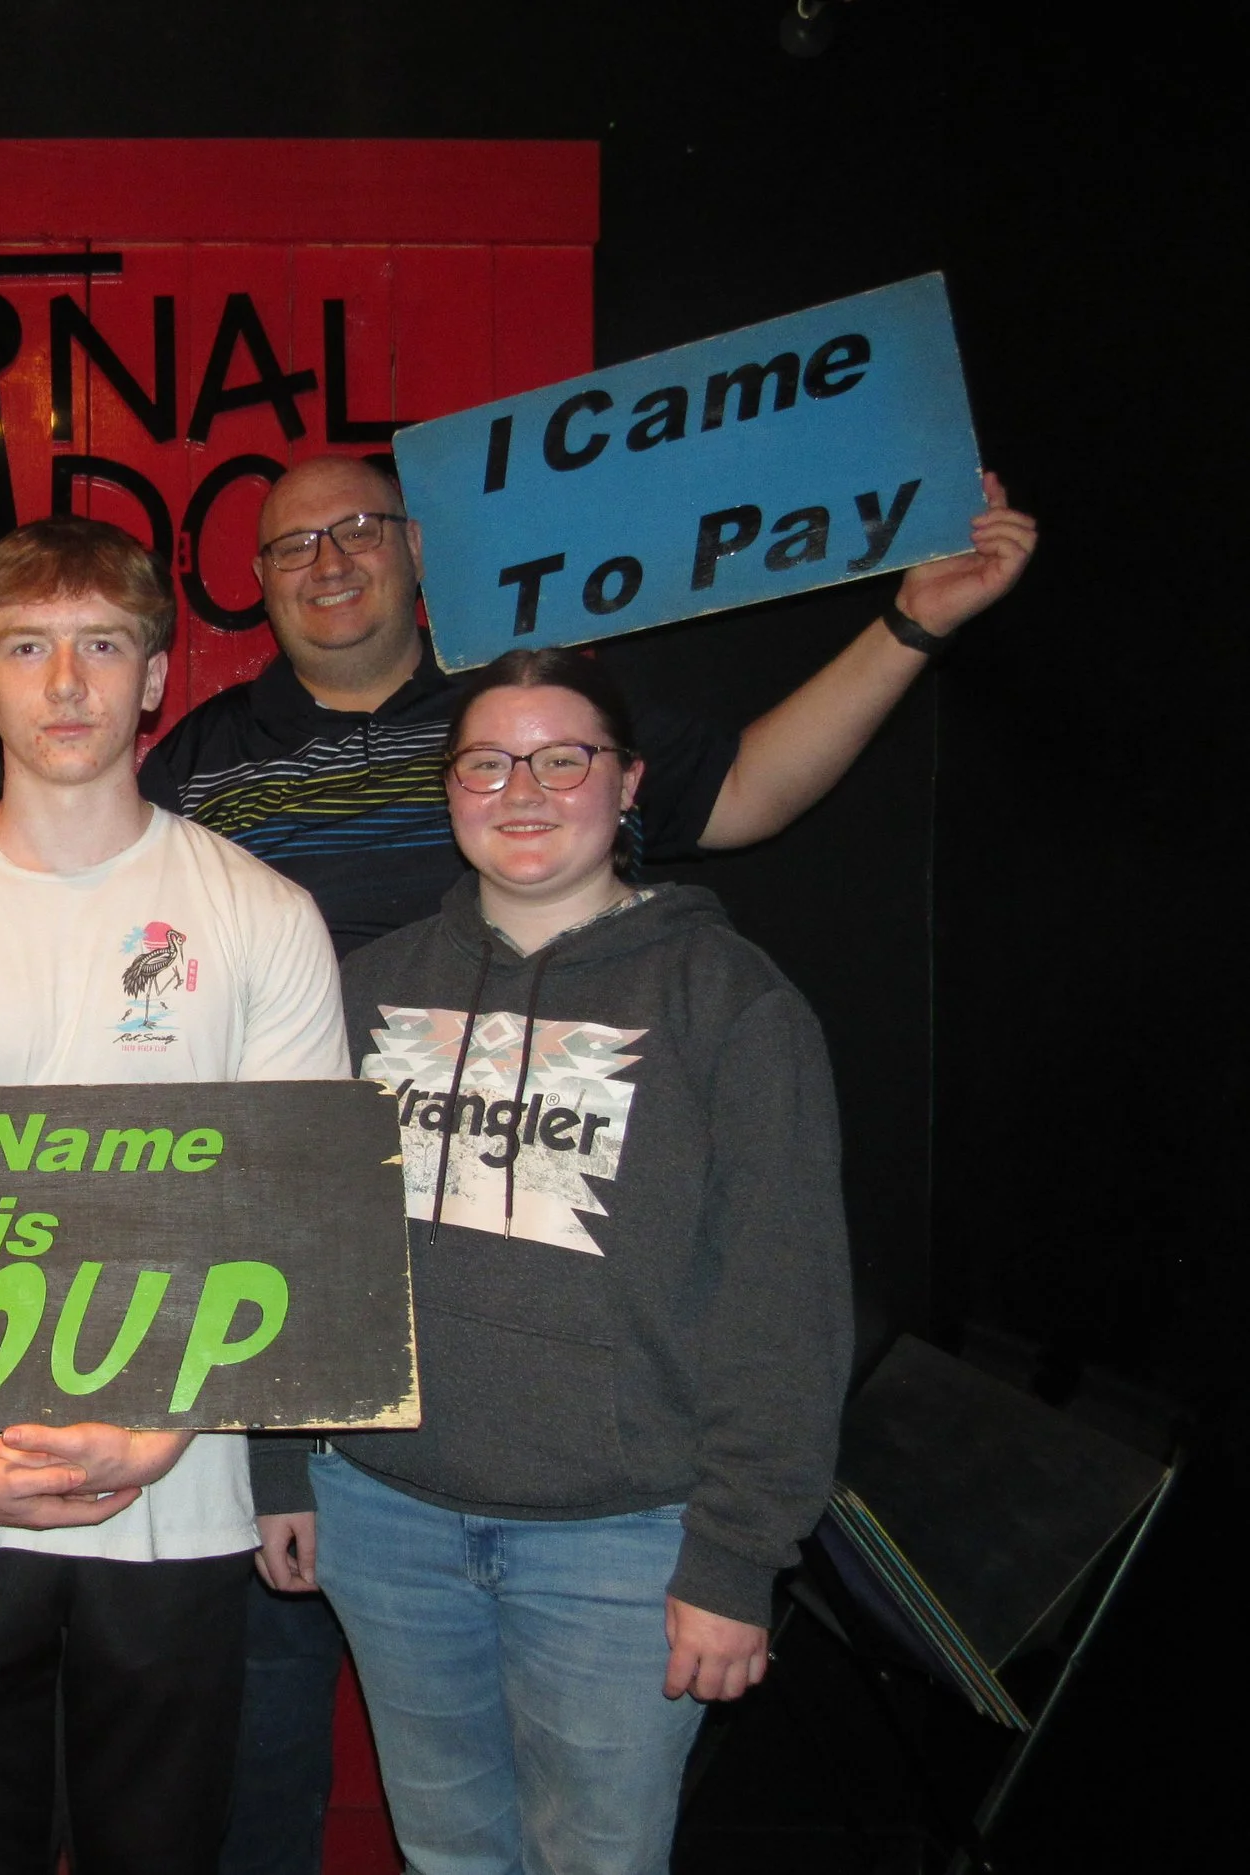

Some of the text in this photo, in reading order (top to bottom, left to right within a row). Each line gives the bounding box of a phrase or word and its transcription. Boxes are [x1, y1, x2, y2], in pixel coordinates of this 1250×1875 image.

[483, 332, 871, 494] I Came
[498, 478, 921, 636] To Pay
[396, 1079, 610, 1168] rangler
